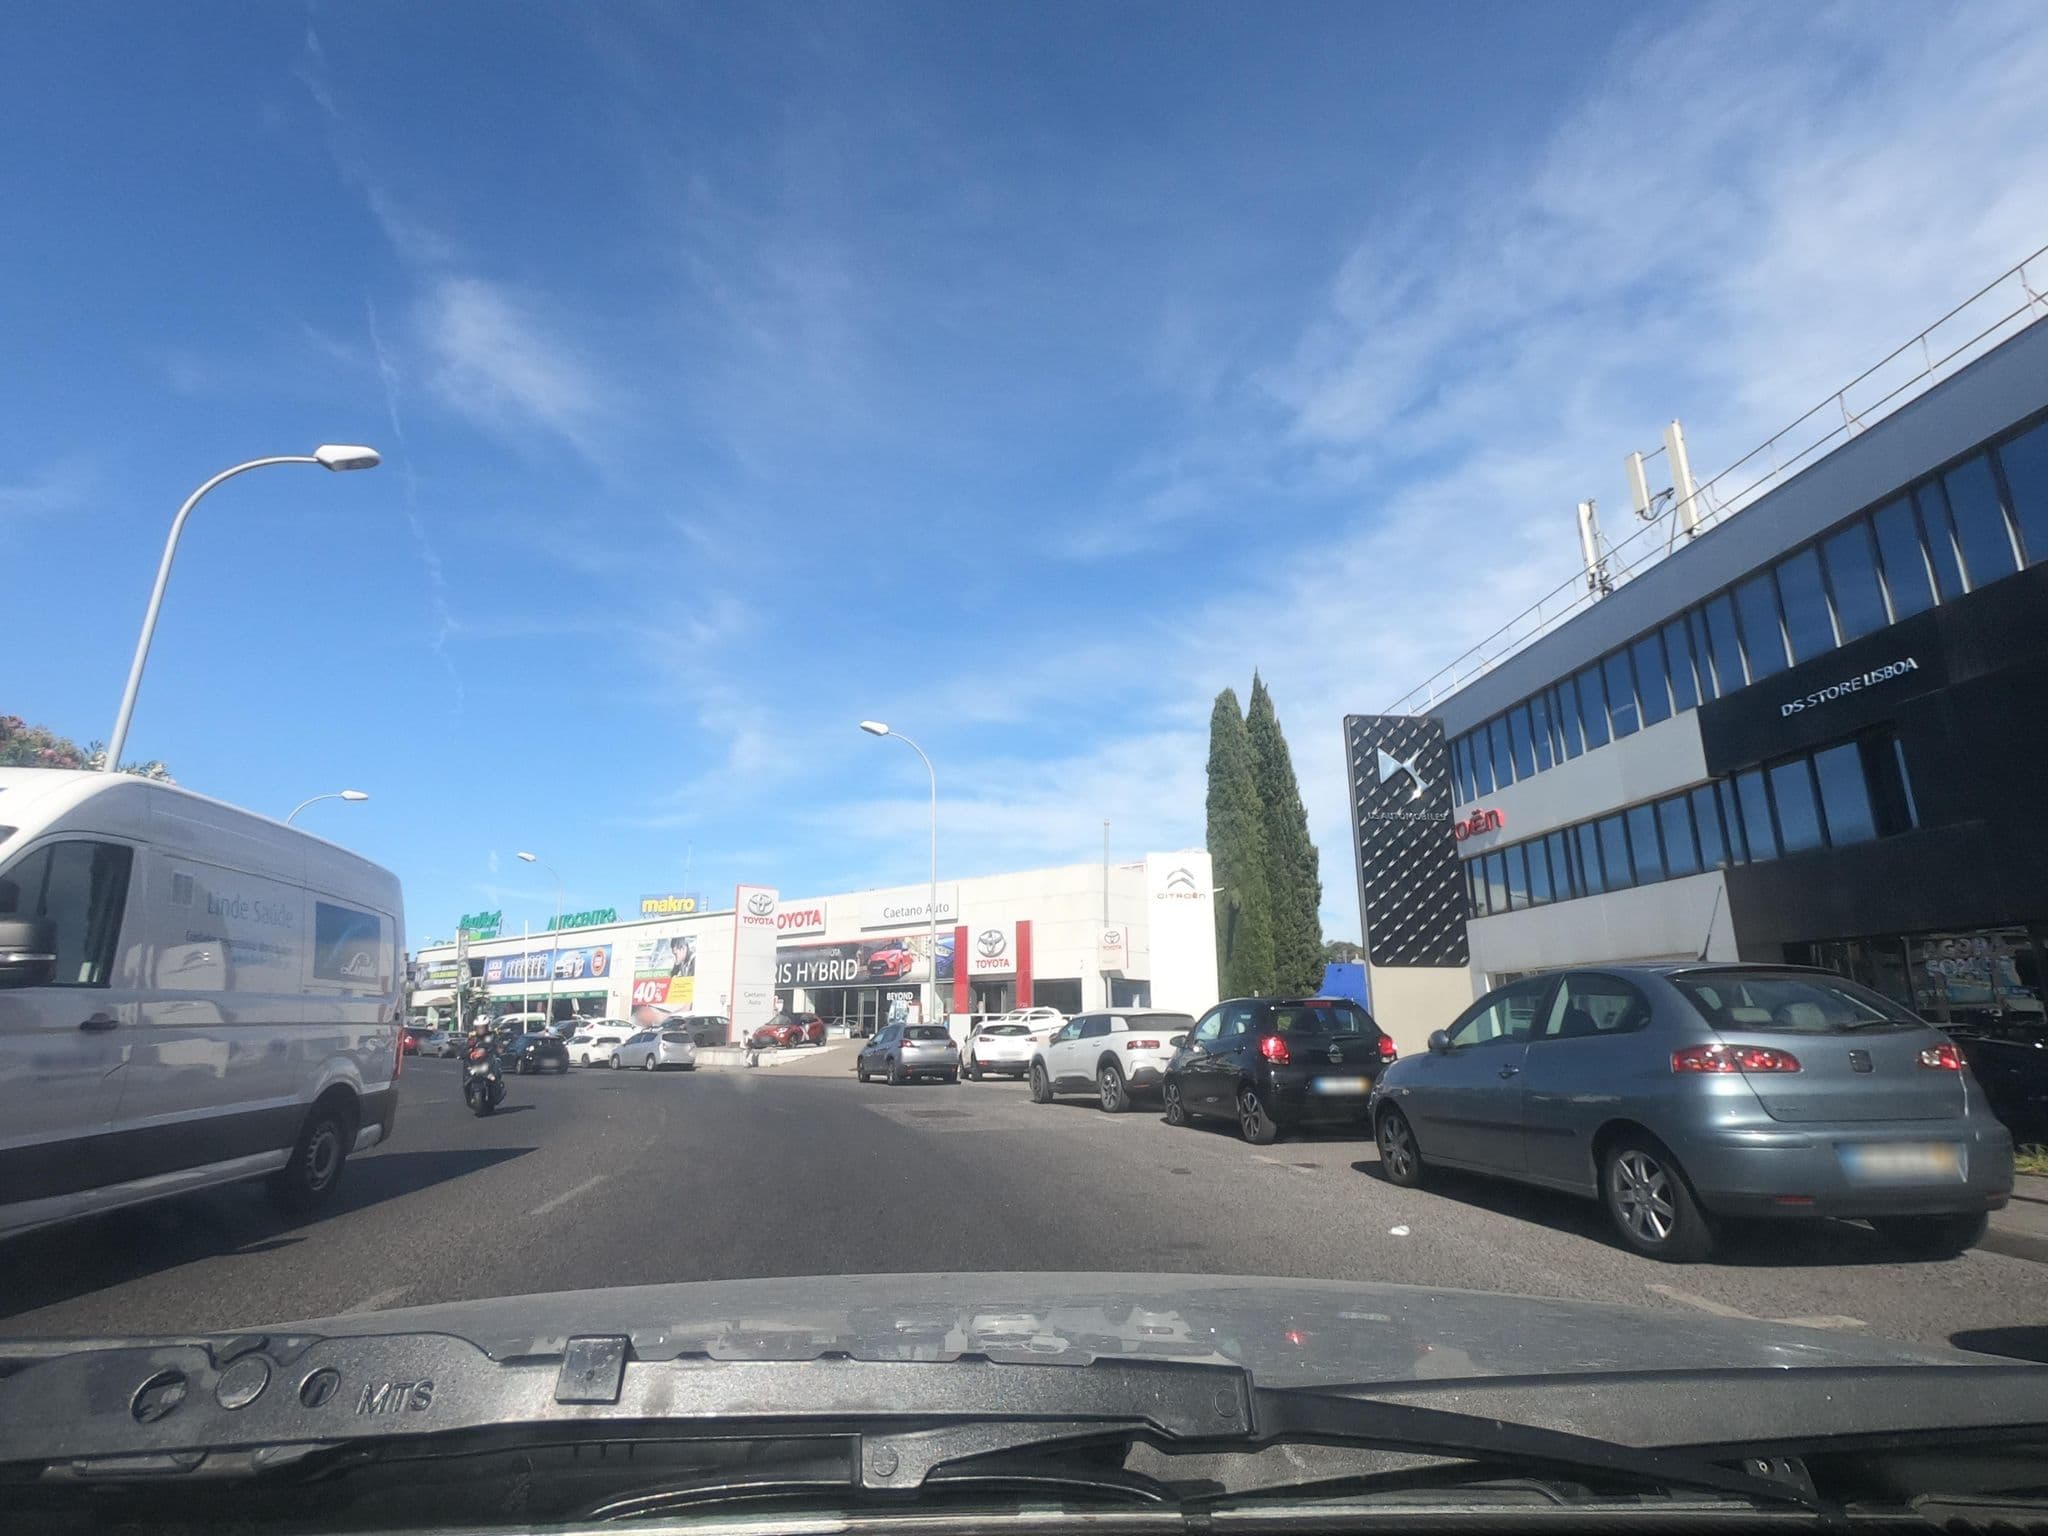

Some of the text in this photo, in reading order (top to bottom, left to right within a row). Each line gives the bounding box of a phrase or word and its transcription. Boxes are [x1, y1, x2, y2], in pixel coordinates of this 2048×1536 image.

[1780, 656, 1919, 717] DS STORE LISBOA
[207, 889, 294, 930] Linde Saúde
[641, 895, 695, 913] makro
[883, 903, 950, 919] Caetano Auto
[742, 915, 775, 926] TOYOTA
[776, 909, 823, 930] OYOTA
[796, 959, 858, 982] HYBRID
[976, 958, 1010, 969] TOYOTA
[886, 992, 914, 1001] BEYOND
[356, 1378, 434, 1415] MTS
